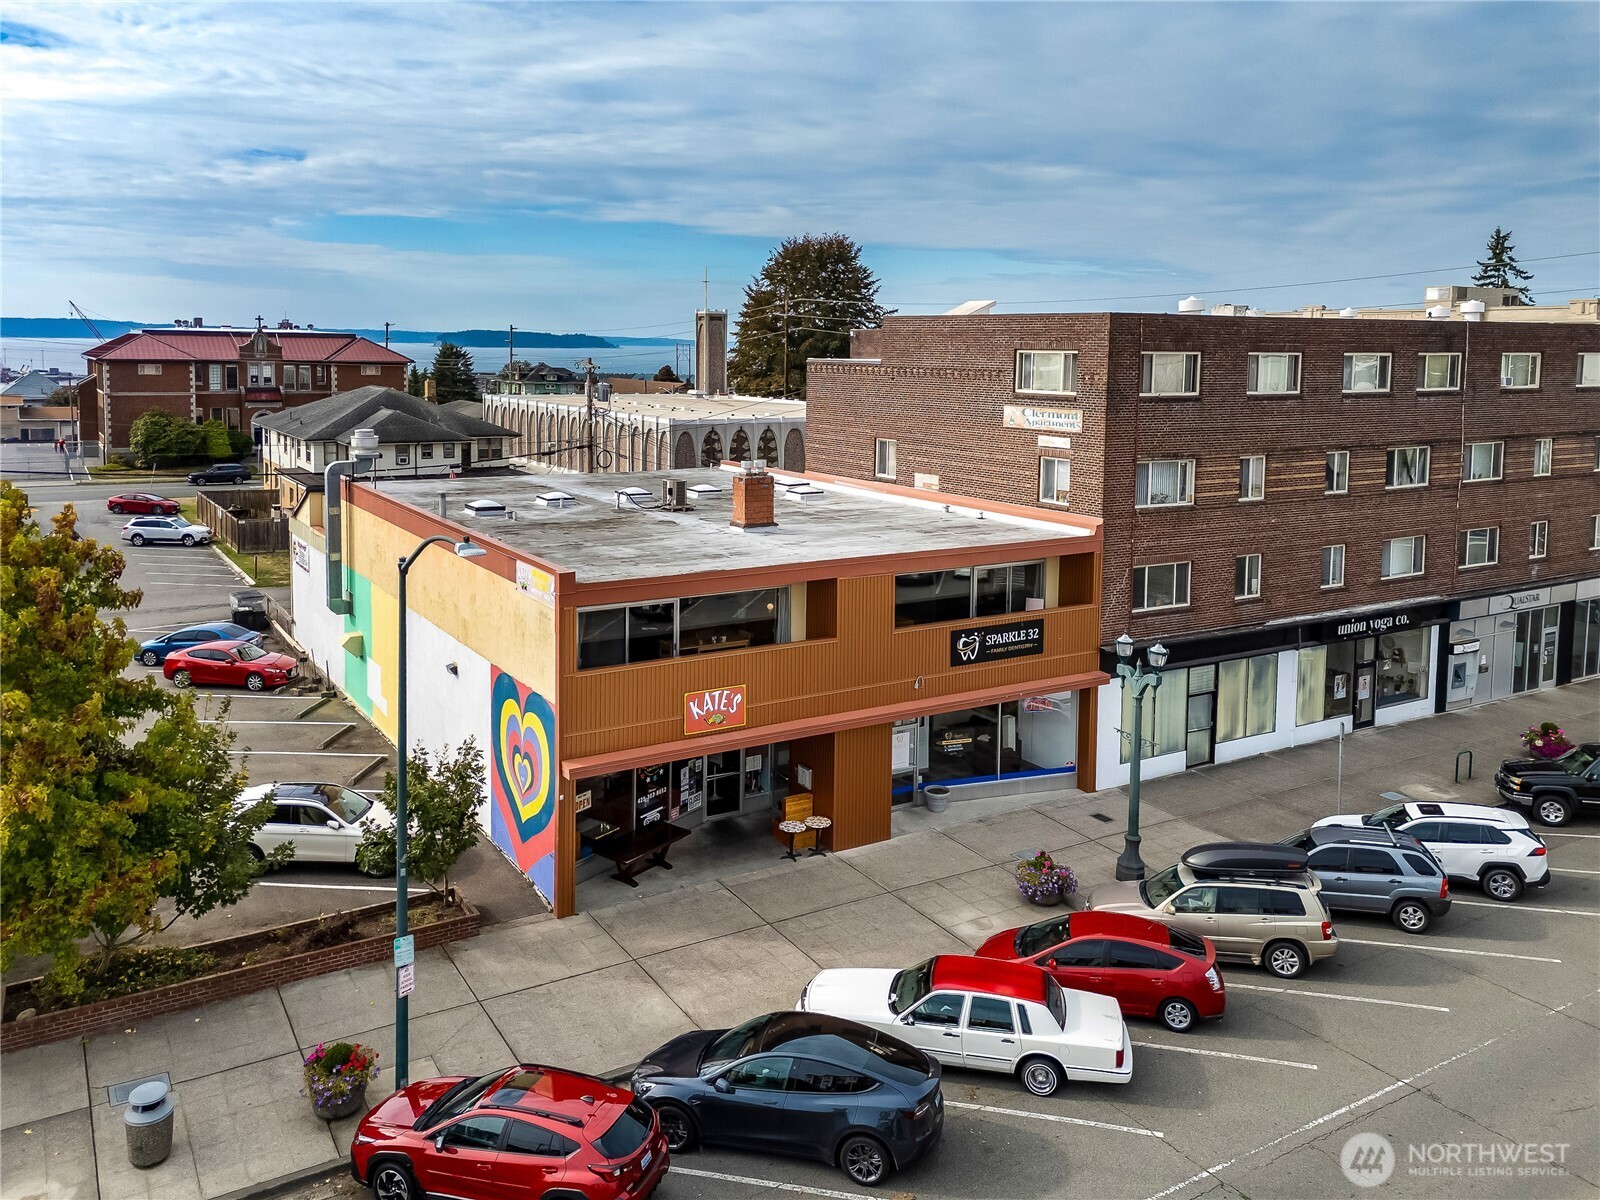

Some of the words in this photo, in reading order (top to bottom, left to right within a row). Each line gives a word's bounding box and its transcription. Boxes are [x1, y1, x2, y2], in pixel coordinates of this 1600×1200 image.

[1021, 407, 1079, 420] Clermont
[1023, 417, 1081, 429] Apartments
[1503, 593, 1540, 609] QUALSTAR
[1337, 618, 1366, 635] union
[1368, 616, 1393, 635] yoga
[1395, 614, 1409, 625] co.
[985, 629, 1026, 645] SPARKLE
[1027, 628, 1039, 639] 32
[990, 646, 1007, 654] FAMILY
[1008, 643, 1034, 651] DENTISTRY
[689, 690, 742, 720] KATE'S
